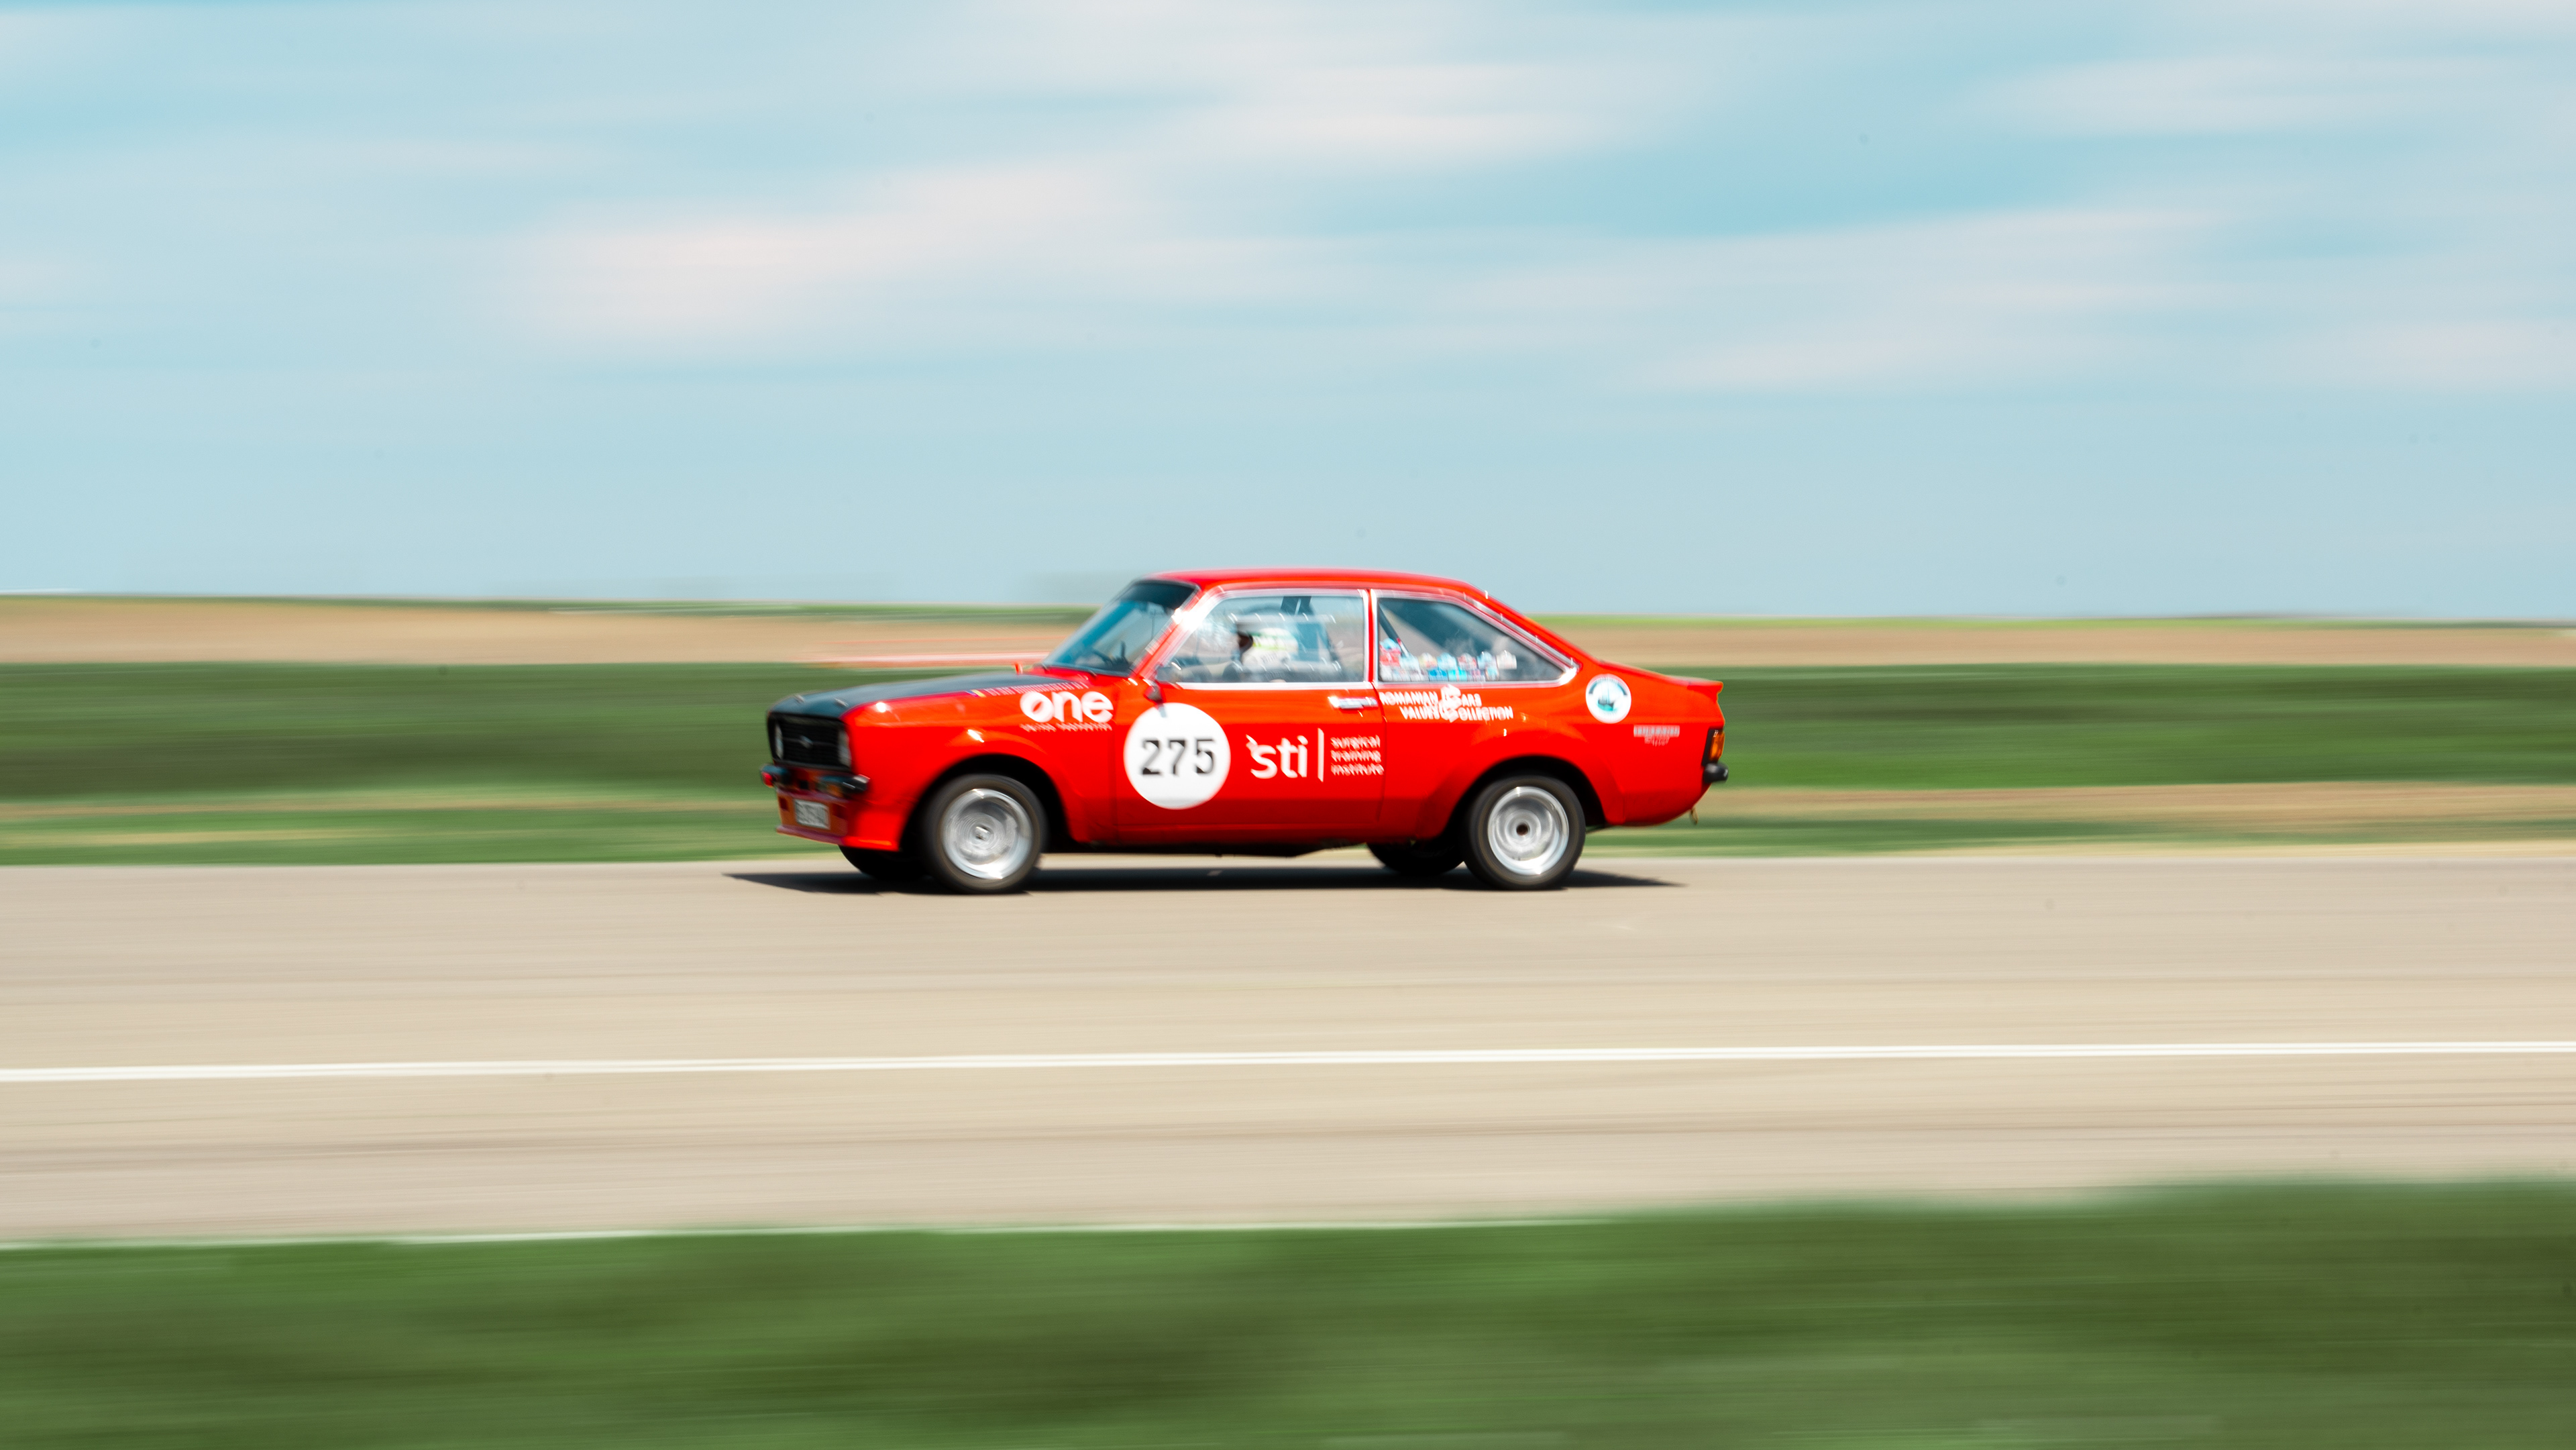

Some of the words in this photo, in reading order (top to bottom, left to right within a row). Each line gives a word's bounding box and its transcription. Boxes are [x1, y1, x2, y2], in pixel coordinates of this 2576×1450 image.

[1020, 690, 1114, 723] one
[1140, 738, 1216, 776] 275
[1246, 735, 1309, 779] sti
